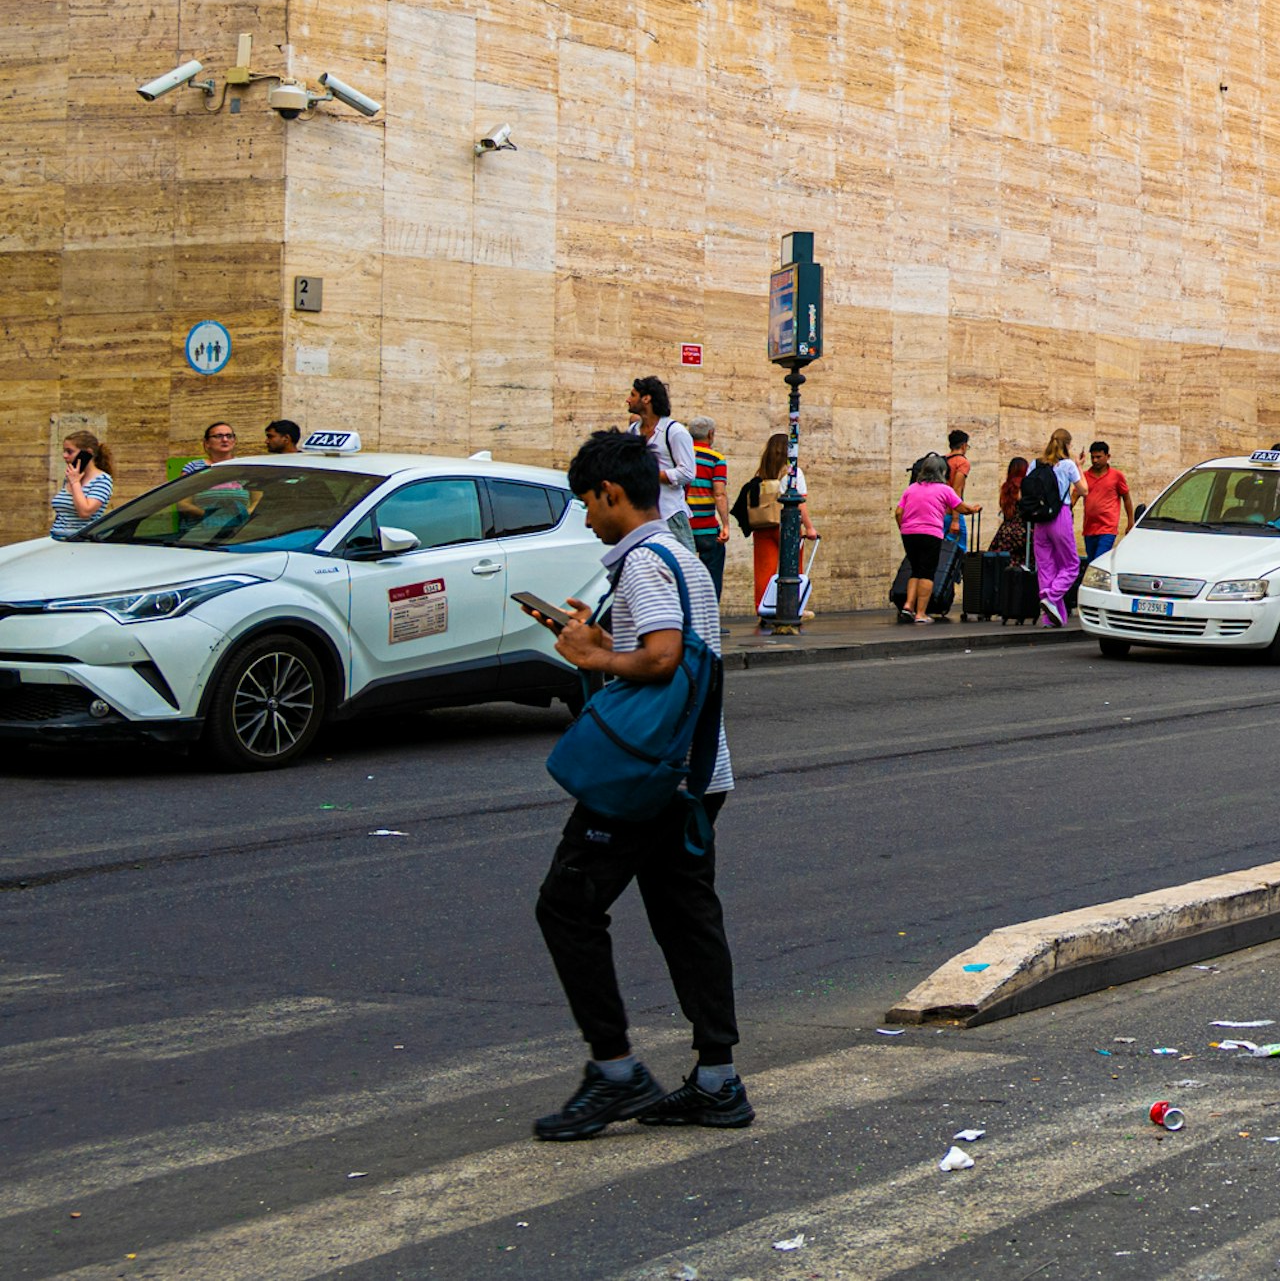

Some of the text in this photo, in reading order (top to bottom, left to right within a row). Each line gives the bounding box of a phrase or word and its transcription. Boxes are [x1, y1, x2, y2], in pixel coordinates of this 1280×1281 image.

[299, 279, 309, 294] 2
[309, 433, 347, 446] TAXI
[1253, 452, 1279, 461] TAXI
